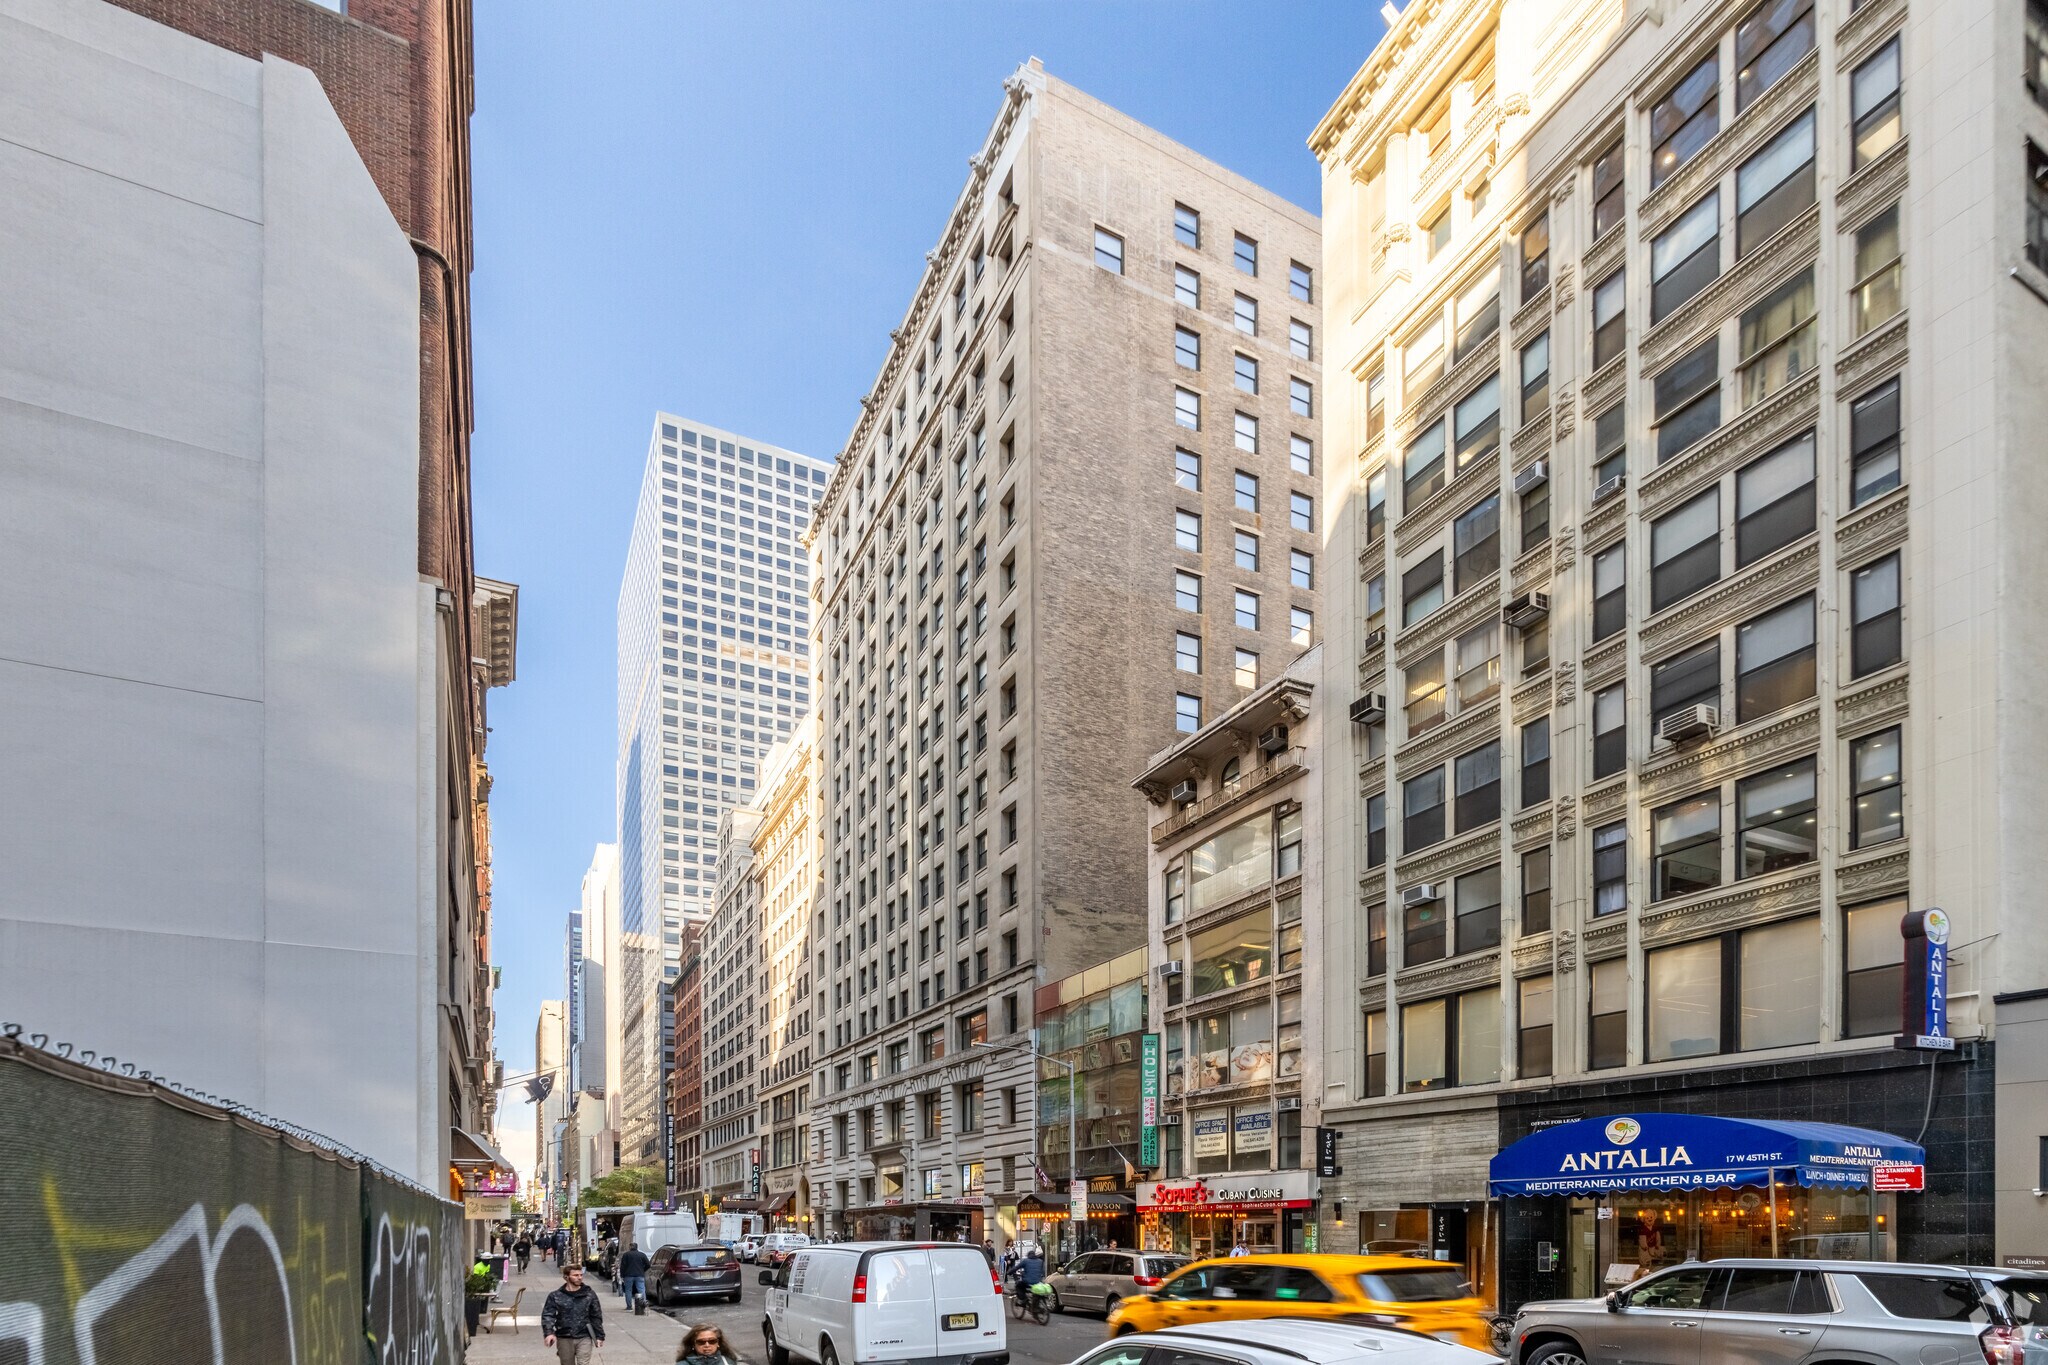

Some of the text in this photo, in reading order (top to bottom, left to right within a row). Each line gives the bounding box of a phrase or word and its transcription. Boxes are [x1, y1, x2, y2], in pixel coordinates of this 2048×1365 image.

[1931, 948, 1942, 1036] ANTALIA
[1942, 1039, 1951, 1048] BAR
[1212, 1119, 1226, 1127] SPACE
[1236, 1114, 1271, 1124] OFFICE SPACE
[1199, 1126, 1223, 1134] AVAILABLE
[1241, 1121, 1267, 1130] AVAILABLE
[1726, 1152, 1783, 1163] 17 W 45TH ST.
[1844, 1146, 1882, 1158] ANTALIA
[1559, 1145, 1693, 1172] ANTALIA
[1810, 1155, 1866, 1166] MEDITERRANEAN
[1867, 1159, 1894, 1167] KITCHEN
[1525, 1173, 1737, 1191] MEDITERRANEAN KITCHEN & BAR
[1806, 1170, 1823, 1181] LUNCH
[1826, 1172, 1845, 1181] DINNER
[1848, 1173, 1861, 1182] TAKE
[1091, 1181, 1117, 1193] DAWSON
[1218, 1189, 1246, 1200] CUBAN
[1248, 1187, 1282, 1199] CUISINE
